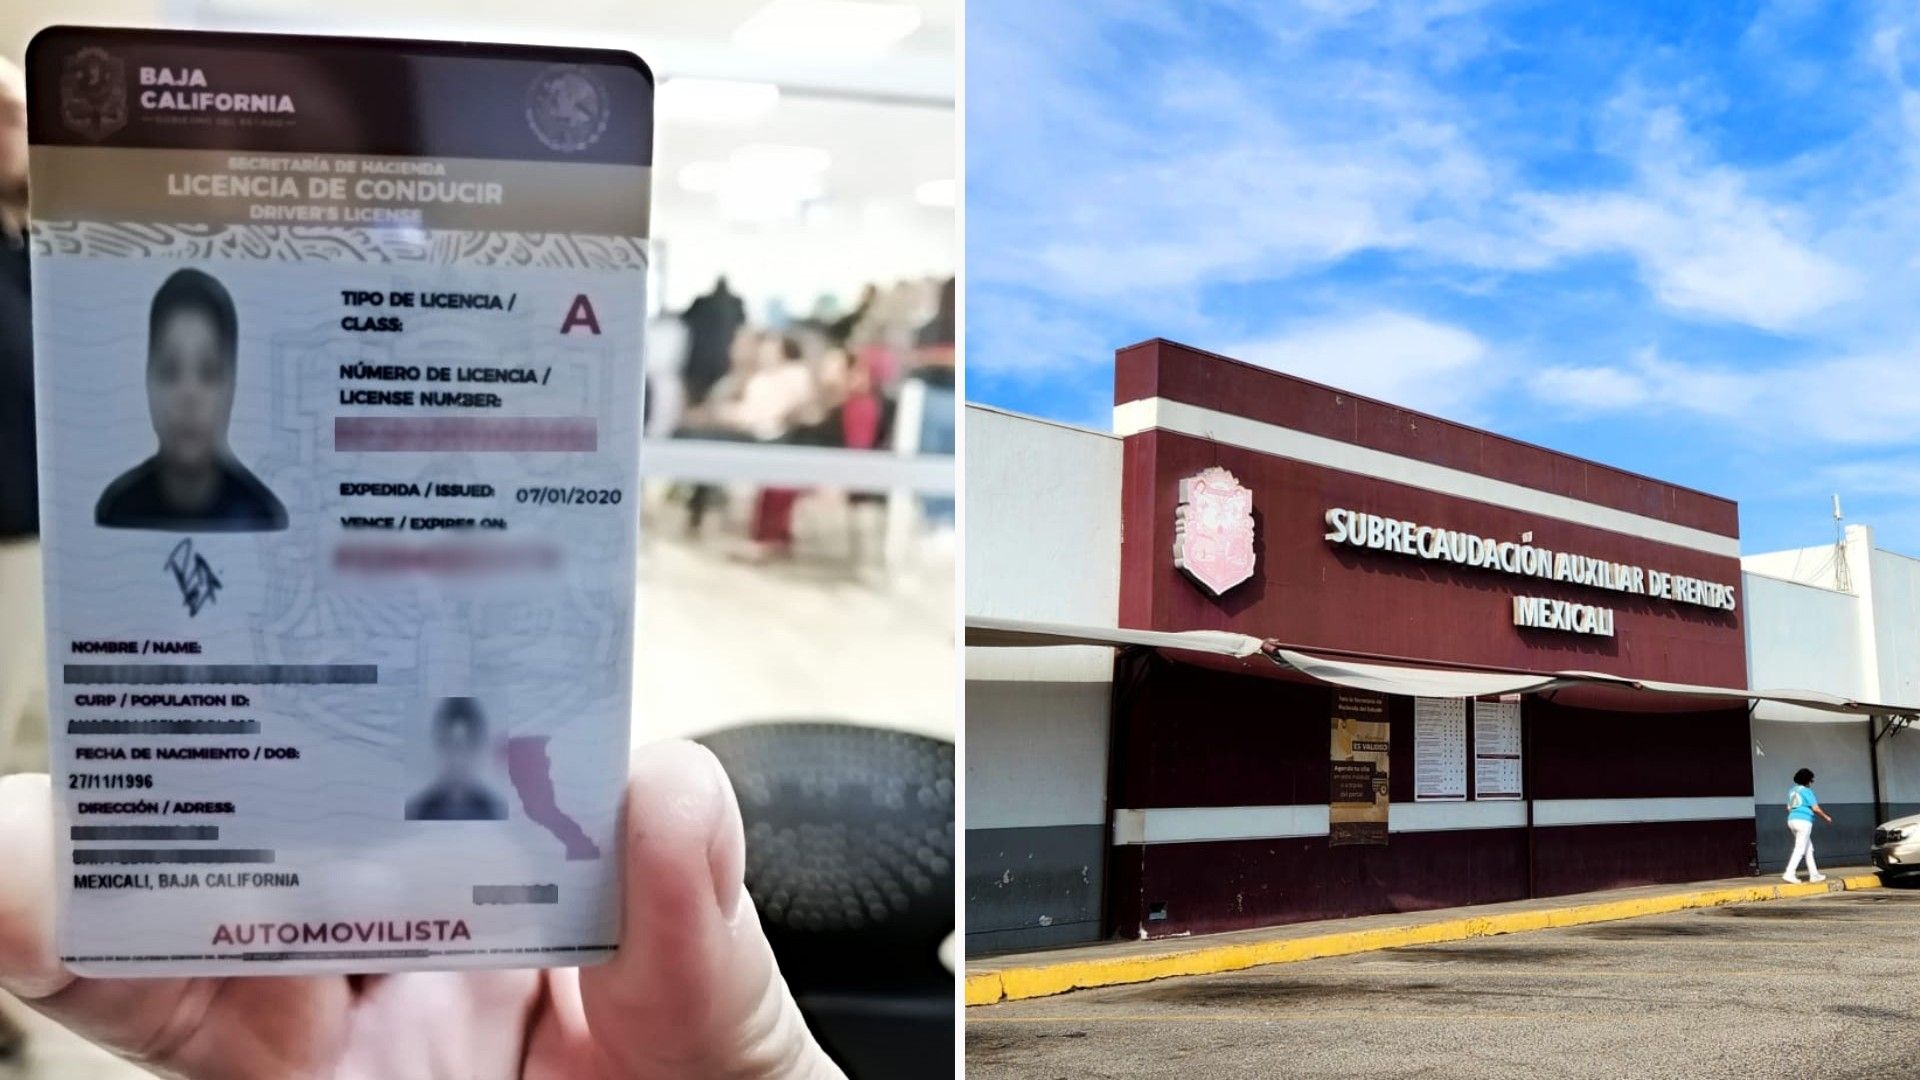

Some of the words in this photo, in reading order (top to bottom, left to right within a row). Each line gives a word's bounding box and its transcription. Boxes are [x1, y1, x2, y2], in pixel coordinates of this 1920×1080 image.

[140, 66, 207, 87] BAJA
[140, 90, 295, 113] CALIFORNIA
[335, 160, 356, 173] DE
[362, 161, 446, 176] HACIENDA
[168, 173, 299, 198] LICENCIA
[308, 177, 346, 200] DE
[355, 179, 503, 204] CONDUCIR
[250, 205, 338, 220] DRIVER'S
[344, 206, 423, 223] LICENSE
[341, 291, 384, 307] TIPO
[390, 292, 415, 307] DE
[420, 293, 503, 310] LICENCIA
[507, 292, 517, 312] /
[560, 294, 602, 335] A
[341, 316, 403, 333] CLASS:
[339, 361, 421, 381] NÚMERO
[426, 366, 452, 382] DE
[457, 367, 538, 384] LICENCIA
[541, 366, 552, 385] /
[339, 390, 414, 406] LICENSE
[420, 391, 503, 408] NUMBER:
[340, 483, 420, 497] EXPEDIDA
[424, 482, 433, 498] /
[436, 484, 496, 498] ISSUED:
[516, 487, 623, 506] 07/01/2020
[340, 517, 395, 529] VENCE
[1324, 508, 1553, 580] SUBRECAUDACIÓN
[1553, 552, 1645, 594] AUXILIAR
[1647, 569, 1672, 599] DE
[1670, 575, 1736, 611] RENTAS
[1513, 595, 1614, 637] MEXICALI
[71, 641, 139, 654] NOMBRE
[153, 641, 202, 654] NAME:
[75, 694, 117, 707] CURP
[131, 694, 227, 707] POPULATION
[231, 694, 251, 707] ID:
[75, 747, 127, 760] FECHA
[131, 747, 151, 760] DE
[156, 747, 250, 761] NACIMIENTO
[264, 748, 301, 761] DOB:
[68, 774, 153, 790] 27/11/1996
[78, 799, 159, 814] DIRECCIÓN
[173, 802, 236, 814] ADRESS:
[73, 874, 154, 890] MEXICALI,
[159, 874, 200, 888] BAJA
[206, 873, 300, 888] CALIFORNIA
[211, 920, 472, 946] AUTOMOVILISTA
